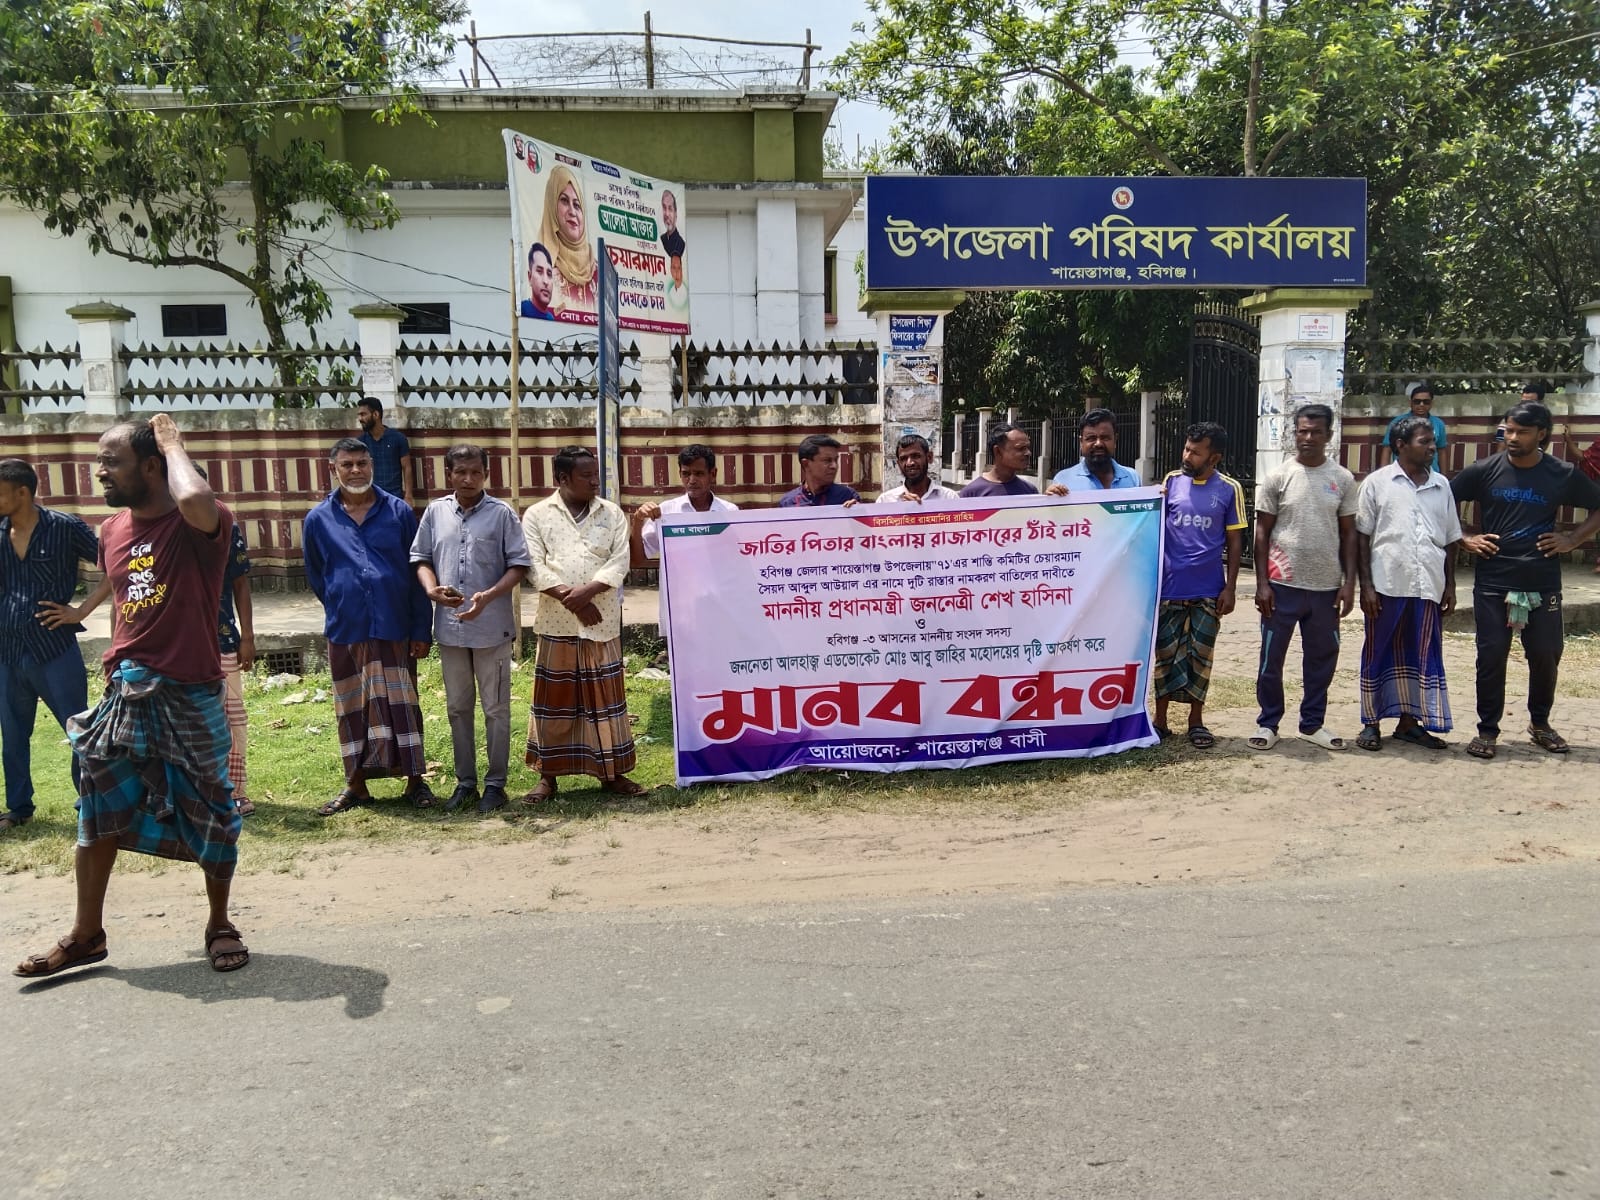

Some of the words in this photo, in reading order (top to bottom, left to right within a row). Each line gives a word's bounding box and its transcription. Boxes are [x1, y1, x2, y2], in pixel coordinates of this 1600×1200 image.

[883, 215, 1054, 261] উপজেলা
[1069, 214, 1198, 260] পরিষদ
[1206, 213, 1356, 260] কার্যালয়
[1050, 266, 1132, 281] শায়েস্তাগঞ্জ,
[873, 514, 915, 526] বিসমিল্লাহির
[953, 511, 974, 521] রাহিম
[1173, 511, 1212, 532] Jeep
[738, 533, 796, 556] জাতির
[800, 532, 855, 552] পিতার
[858, 533, 926, 549] বাংলায়
[929, 528, 1023, 547] রাজাকারের
[1026, 519, 1057, 540] ঠাঁই
[1059, 518, 1092, 537] নাই
[760, 565, 793, 579] হবিগঞ্জ
[797, 565, 828, 577] জেলার
[831, 563, 881, 575] শায়েস্তাগঞ্জ
[971, 554, 994, 567] শান্তি
[996, 551, 1031, 566] কমিটির
[1034, 551, 1082, 564] চেয়ারম্যান
[757, 582, 785, 595] সৈয়দ
[788, 582, 817, 595] আব্দুল
[820, 579, 859, 591] আউয়াল
[863, 579, 878, 589] এর
[881, 578, 904, 589] নামে
[907, 574, 925, 590] দুটি
[927, 575, 954, 587] রাস্তার
[958, 573, 996, 584] নামকরণ
[999, 569, 1039, 582] বাতিলের
[1042, 565, 1075, 580] দাবীতে
[762, 596, 823, 621] মাননীয়
[829, 591, 904, 620] প্রধানমন্ত্রী
[909, 587, 975, 614] জননেত্রী
[981, 588, 1015, 610] শেখ
[1019, 583, 1073, 609] হাসিনা
[826, 633, 859, 646] হবিগঞ্জ
[878, 633, 916, 645] আসনের
[919, 628, 952, 643] মাননীয়
[956, 629, 982, 641] সংসদ
[986, 627, 1012, 638] সদস্য
[915, 618, 926, 630] ও
[729, 657, 773, 675] জননেতা
[824, 648, 881, 668] এডভোকেট
[884, 649, 907, 665] মোঃ
[910, 650, 933, 668] আবু
[935, 644, 966, 664] জাহির
[969, 644, 1020, 662] মহোদয়ের
[1023, 638, 1042, 664] দৃষ্টি
[1045, 635, 1081, 656] আকর্ষণ
[1084, 637, 1106, 652] করে
[696, 678, 927, 741] মানব
[939, 663, 1142, 722] বন্ধন
[915, 736, 1003, 756] শায়েস্তাগঞ্জ
[1007, 728, 1047, 749] বাসী
